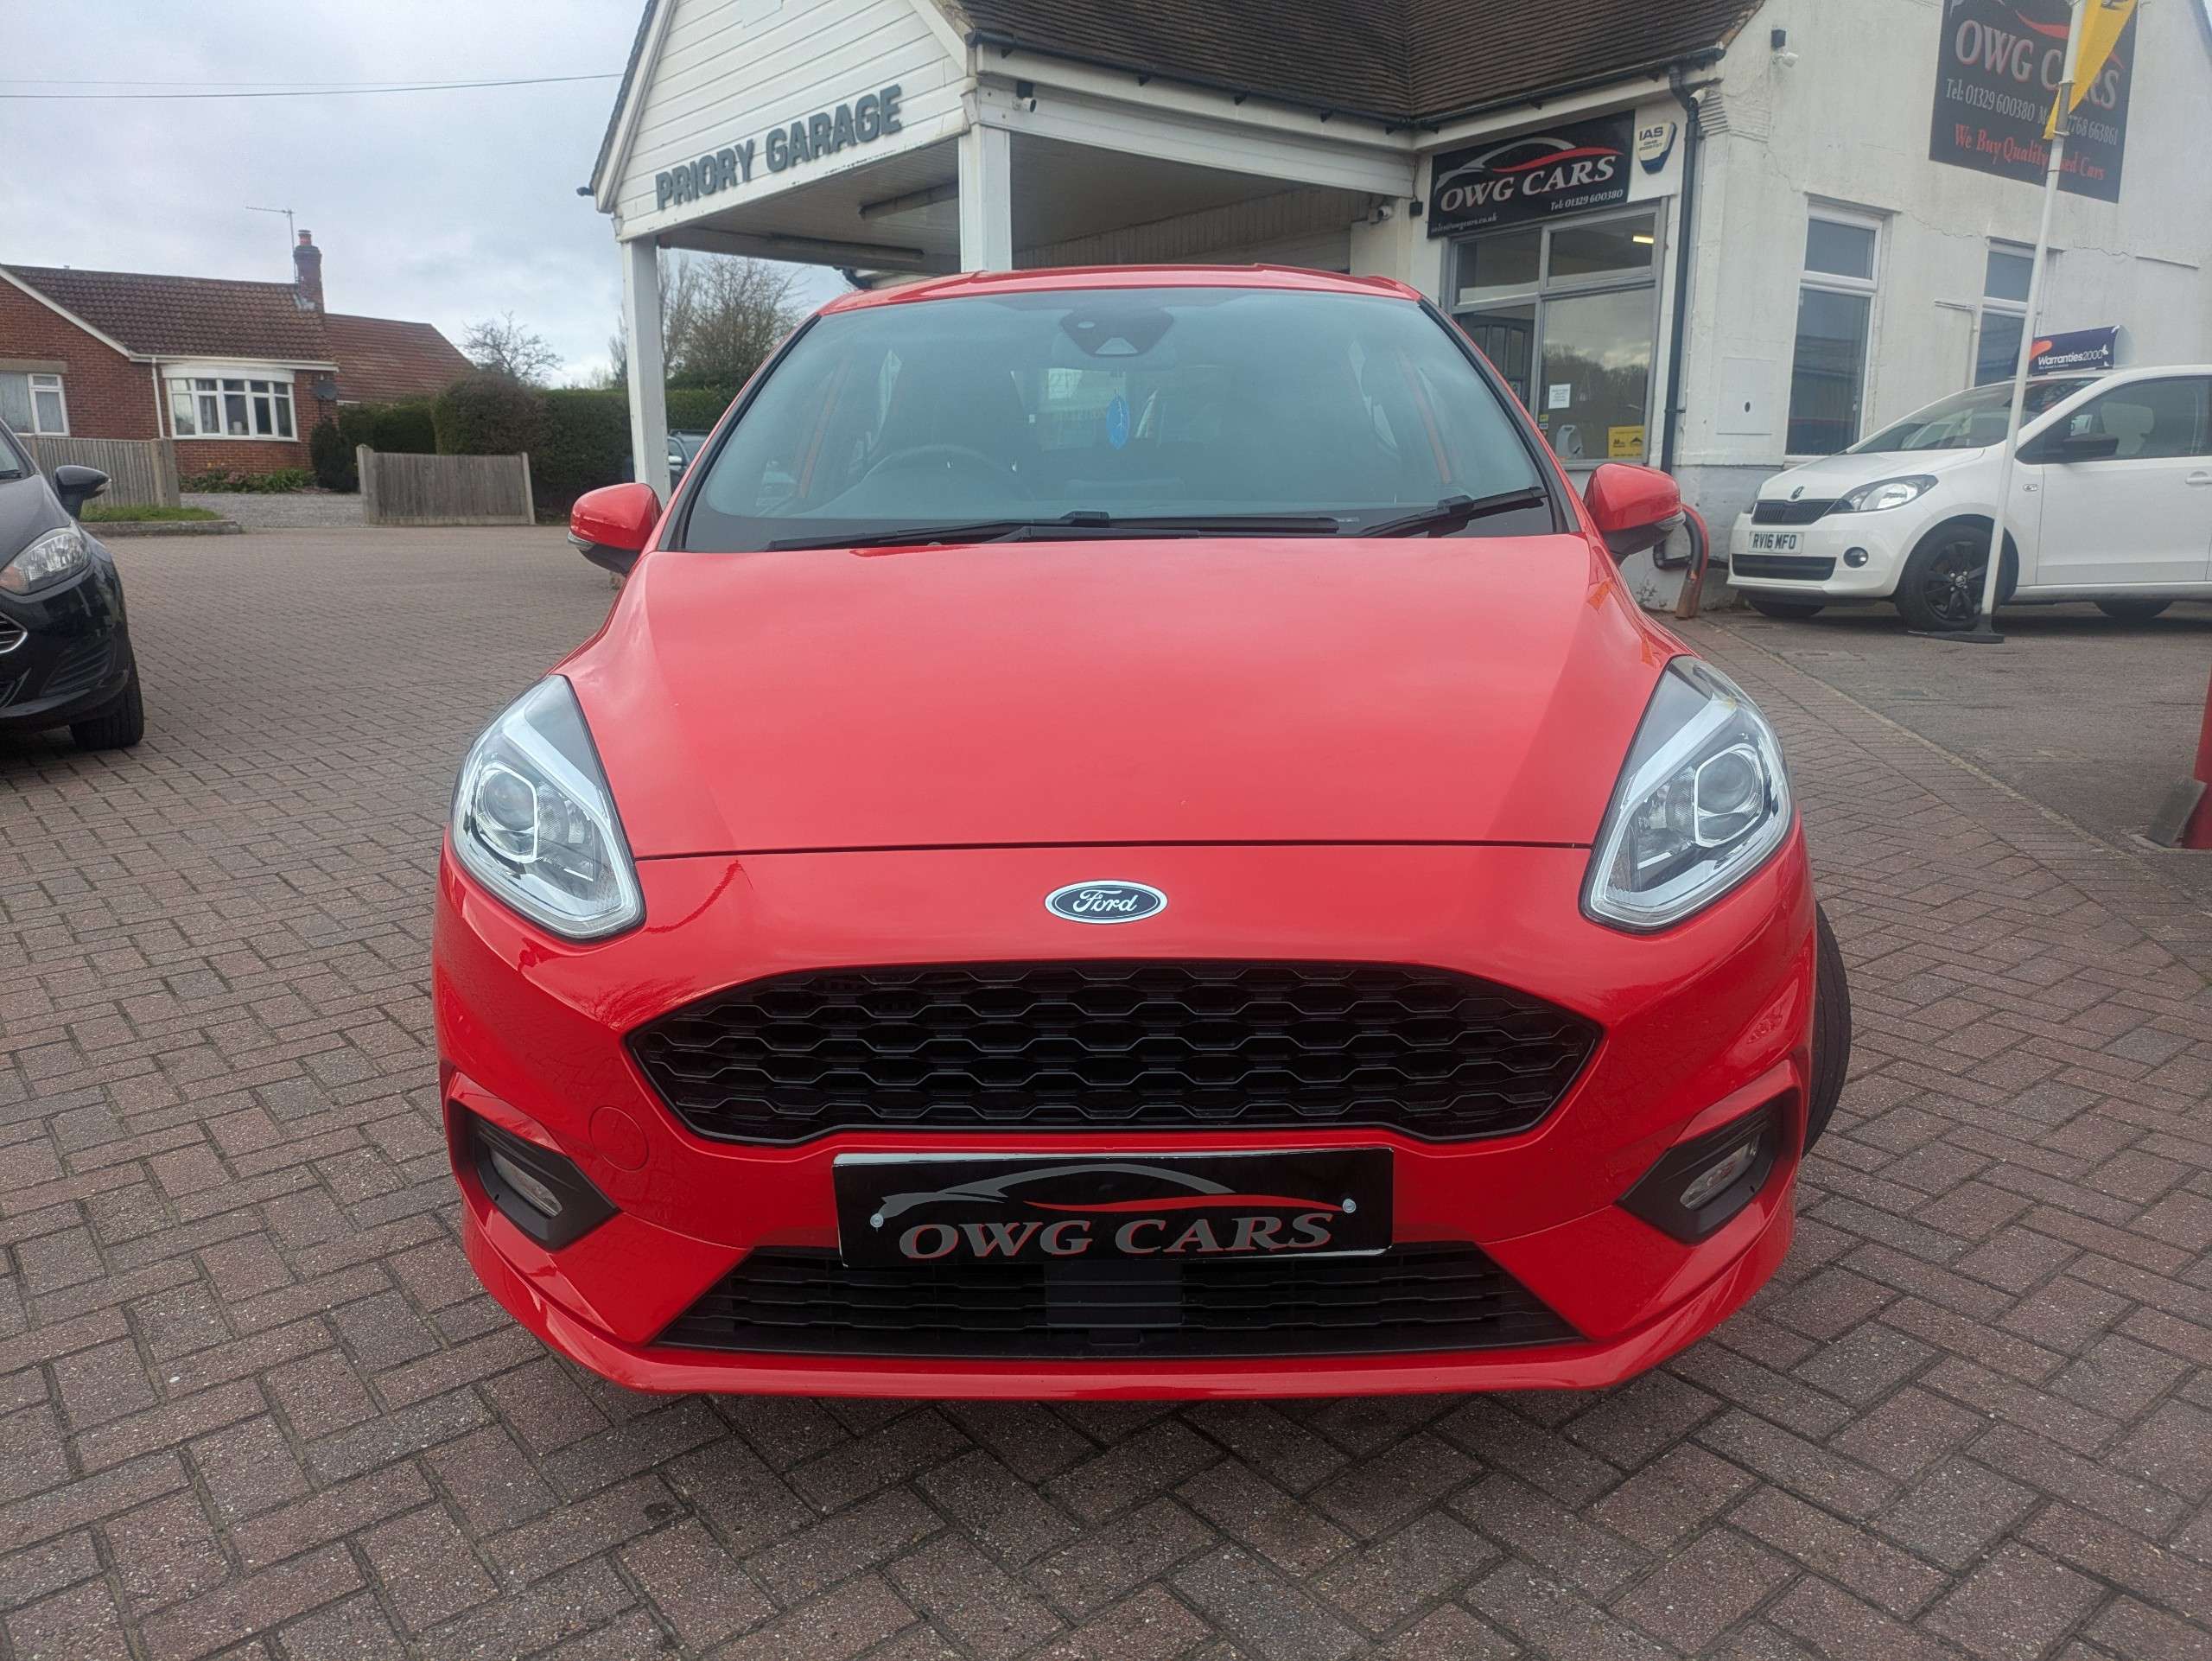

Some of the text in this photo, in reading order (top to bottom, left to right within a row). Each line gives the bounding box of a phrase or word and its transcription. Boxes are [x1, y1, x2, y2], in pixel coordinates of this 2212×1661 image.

[1955, 19, 2033, 83] OWG
[1946, 78, 1963, 101] Tel:
[1965, 84, 1995, 111] 01329
[1996, 93, 2036, 121] 600380
[656, 84, 903, 210] PRIORY GARAGE
[1638, 126, 1663, 141] IAS
[1955, 124, 1972, 150] We
[1976, 129, 2003, 164] Buy
[2004, 137, 2050, 175] Quality
[1440, 156, 1617, 212] OWG CARS
[1589, 188, 1624, 204] 600380
[1752, 532, 1797, 550] RV16 MFO
[1072, 889, 1137, 913] Ford
[899, 1212, 1334, 1259] OWG CARS
